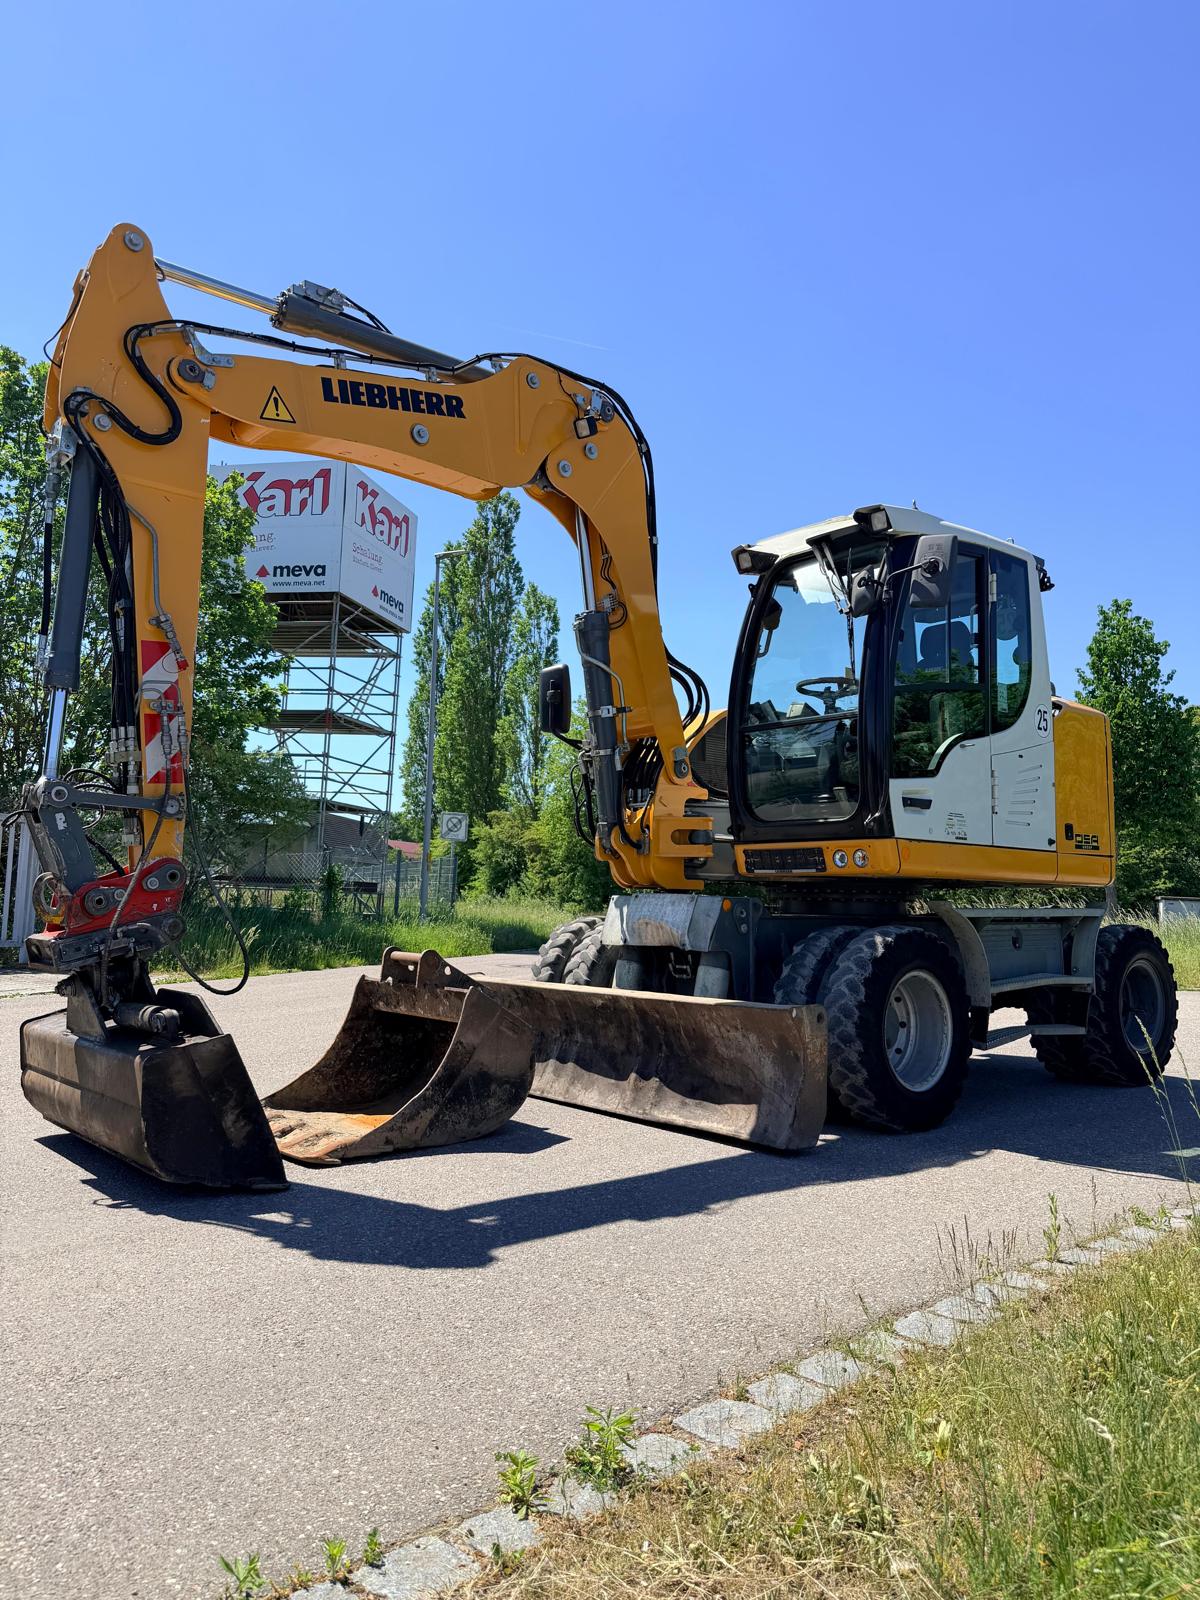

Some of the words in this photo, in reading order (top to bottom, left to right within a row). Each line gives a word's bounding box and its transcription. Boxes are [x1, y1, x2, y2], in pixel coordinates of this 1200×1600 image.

[321, 376, 466, 419] LIEBHERR
[226, 468, 331, 518] Karl
[355, 480, 410, 558] Karl
[273, 565, 326, 577] meva
[380, 590, 404, 613] meva
[1037, 709, 1048, 732] 25
